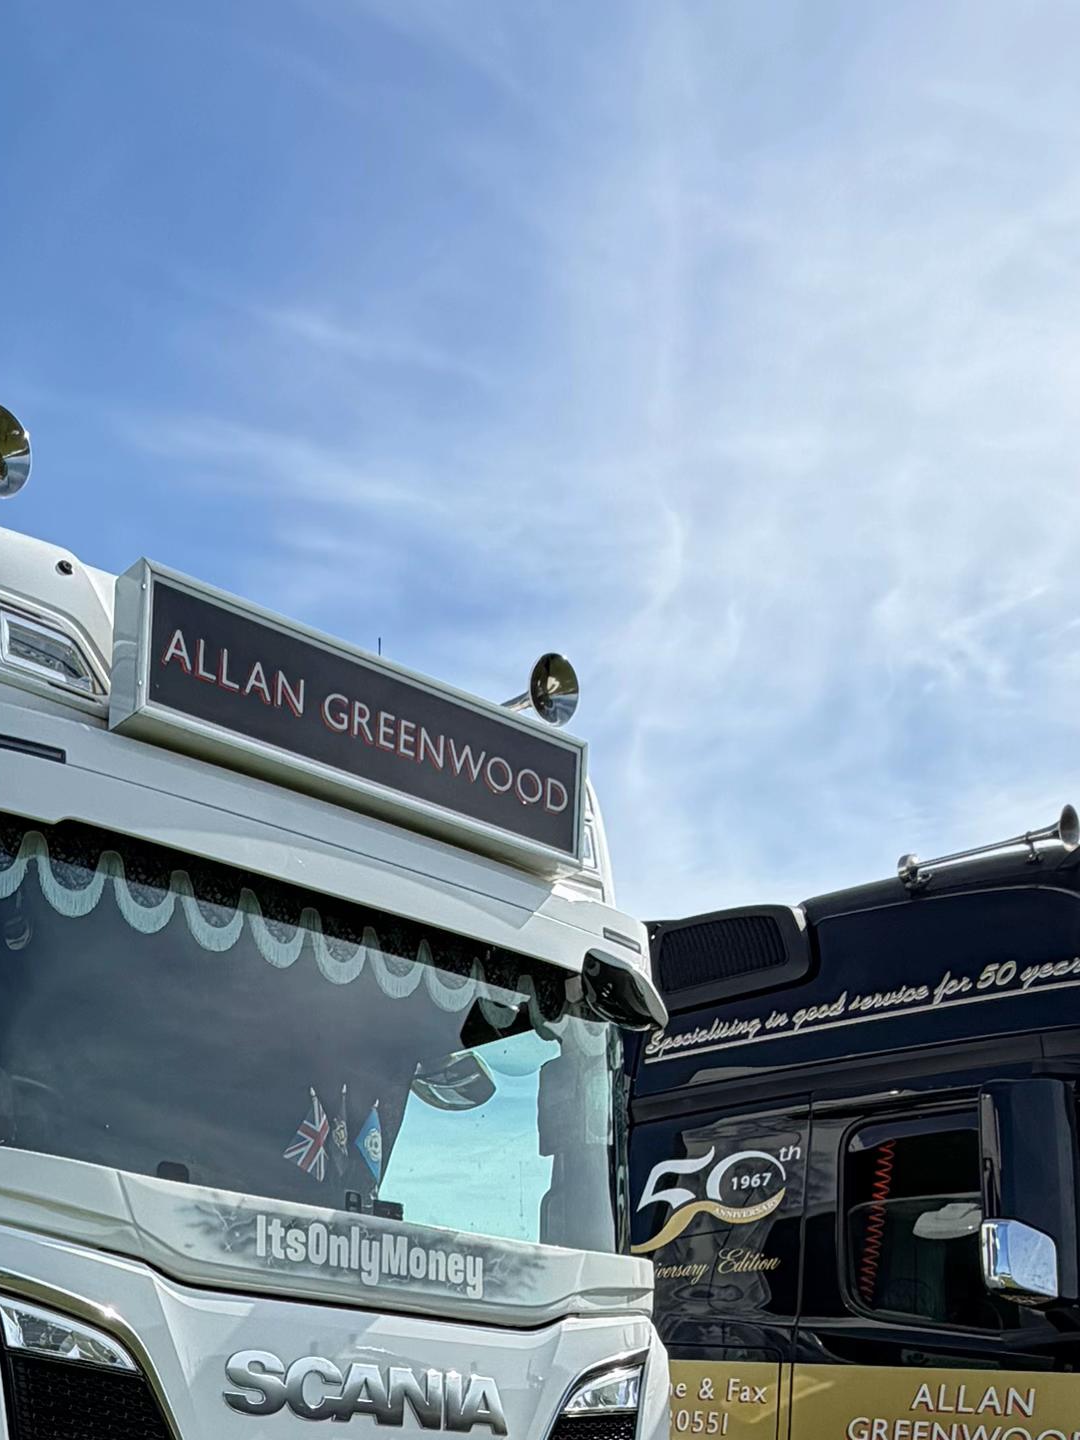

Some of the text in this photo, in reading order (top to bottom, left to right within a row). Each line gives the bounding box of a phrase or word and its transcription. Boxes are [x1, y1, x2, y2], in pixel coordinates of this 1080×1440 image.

[162, 629, 569, 815] ALLAN GREENWOOD
[645, 1017, 762, 1057] Specialising
[765, 1010, 789, 1030] in
[792, 991, 849, 1033] good
[848, 984, 929, 1012] service
[932, 970, 974, 1007] for
[976, 960, 1018, 990] 50
[731, 1172, 772, 1191] 1967
[255, 1214, 484, 1300] ItsOnlyMoney
[717, 1247, 782, 1274] Edition
[222, 1348, 508, 1437] SCANIA
[698, 1377, 715, 1401] &
[725, 1377, 768, 1404] Fax
[910, 1382, 1037, 1418] ALLAN
[670, 1408, 729, 1436] 0551
